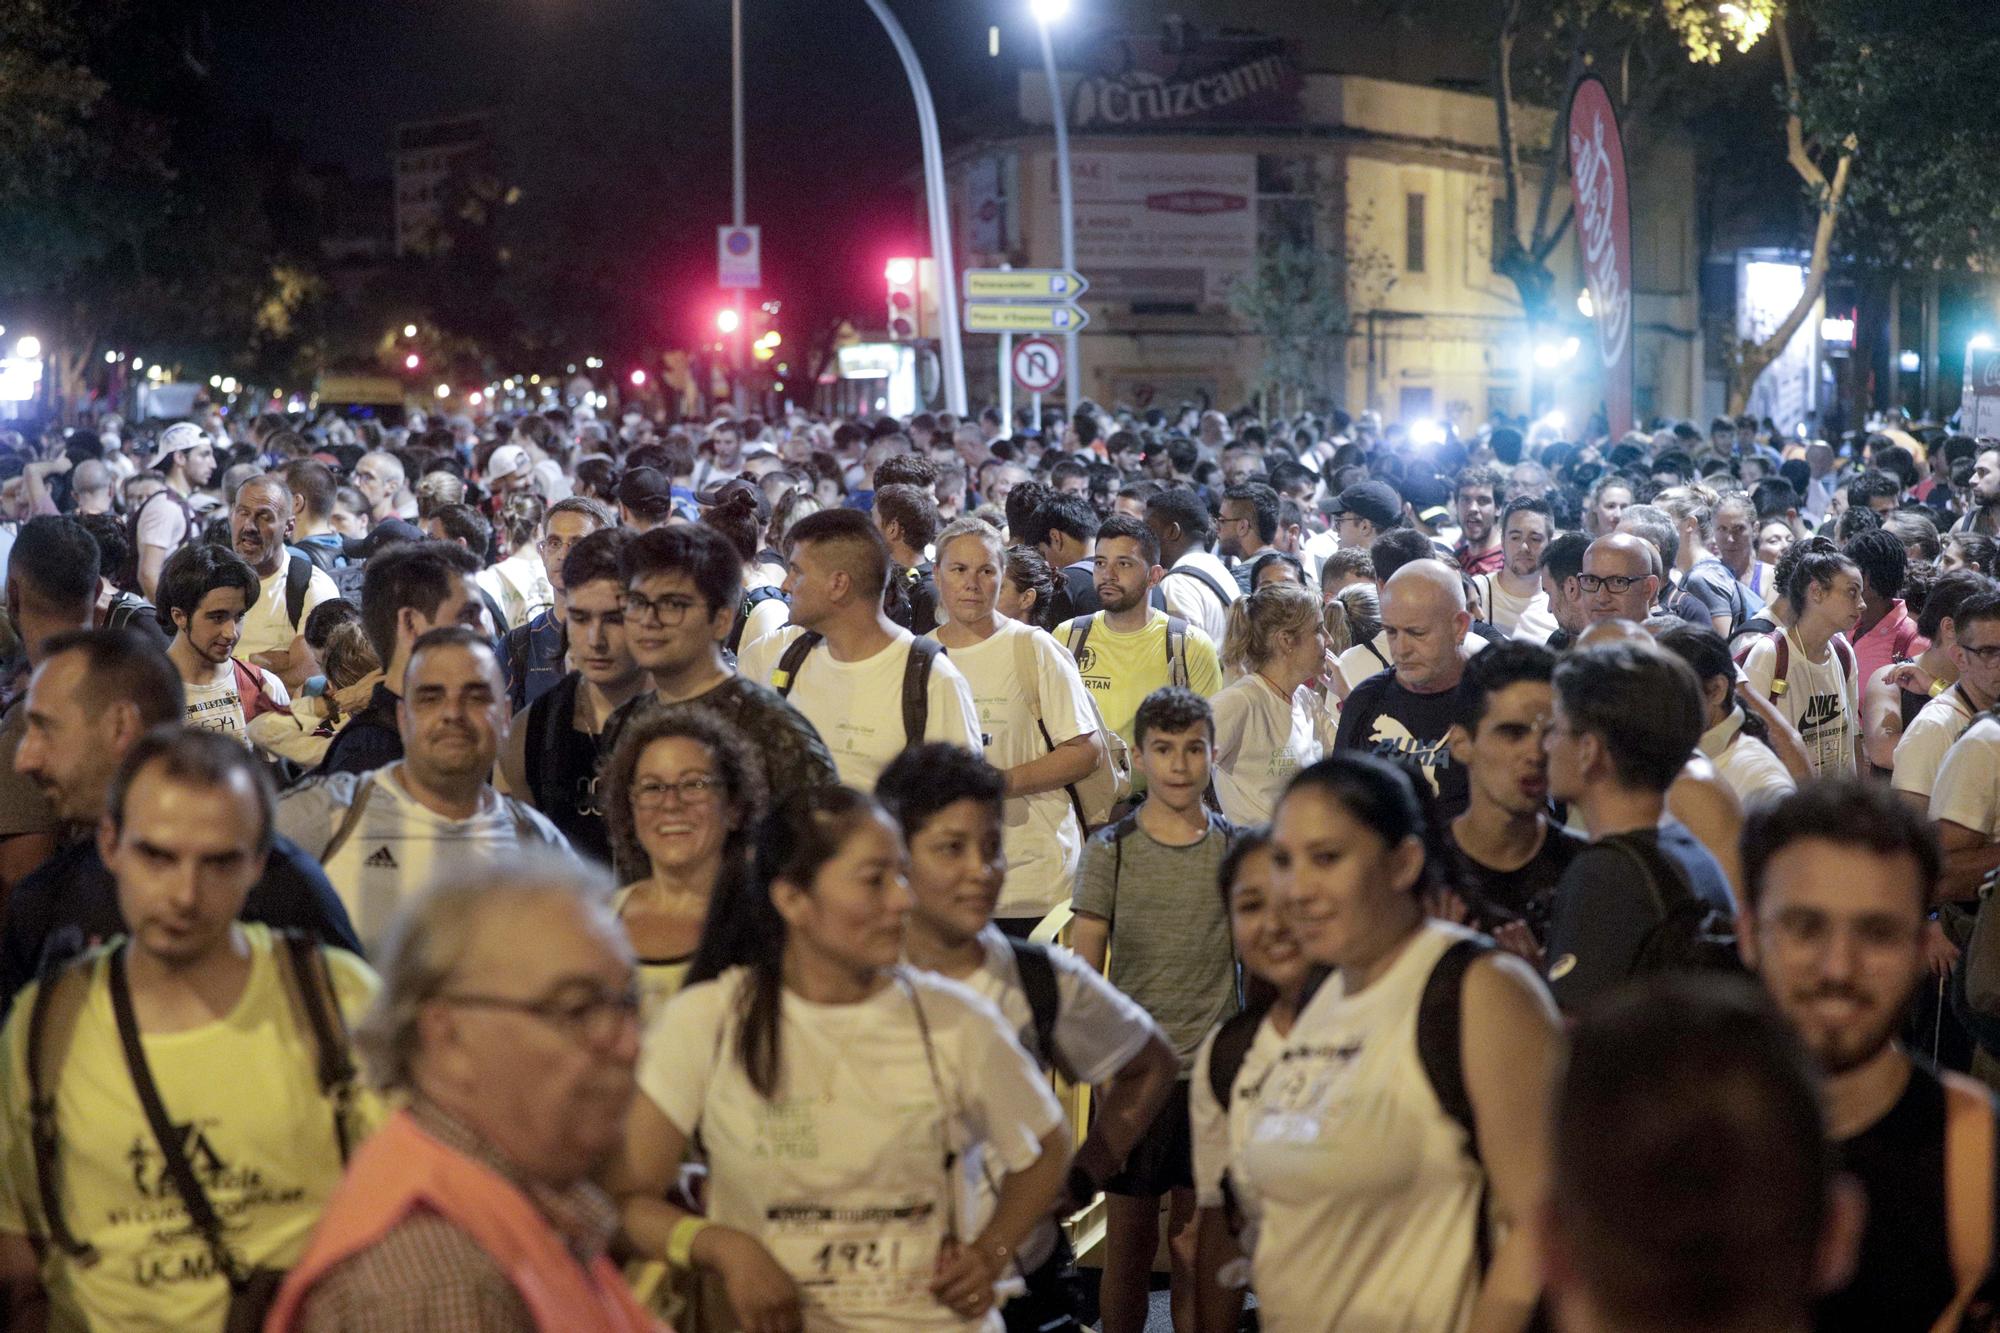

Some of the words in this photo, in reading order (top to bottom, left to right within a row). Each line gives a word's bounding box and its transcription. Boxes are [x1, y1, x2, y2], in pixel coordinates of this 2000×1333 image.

[1099, 55, 1284, 123] Cruzcamp
[1083, 680, 1111, 690] RTAN
[196, 699, 227, 711] DORSAL
[1807, 693, 1839, 717] NIKE
[1370, 737, 1450, 769] PUMA
